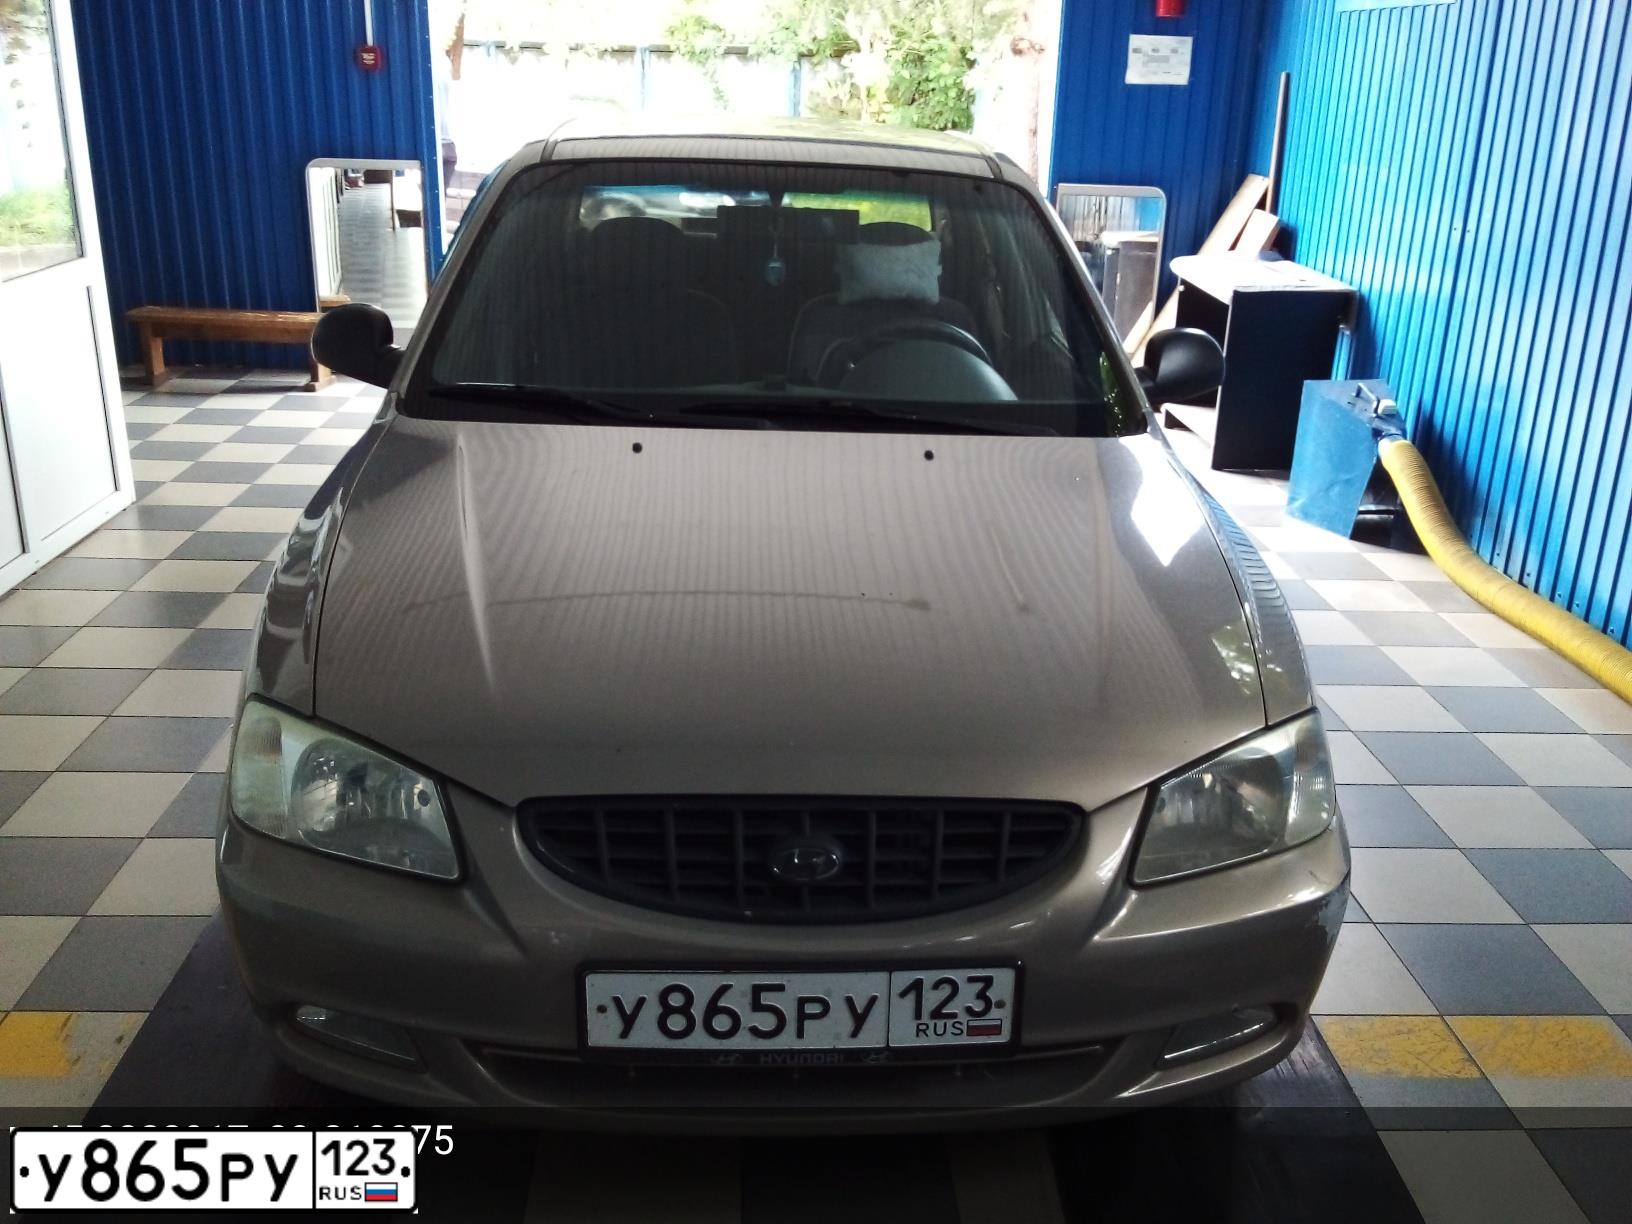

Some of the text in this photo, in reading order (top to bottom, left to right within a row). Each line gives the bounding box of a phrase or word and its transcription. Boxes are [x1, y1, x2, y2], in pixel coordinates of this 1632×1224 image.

[612, 975, 994, 1040] У865РУ 123
[915, 1021, 964, 1037] RUS
